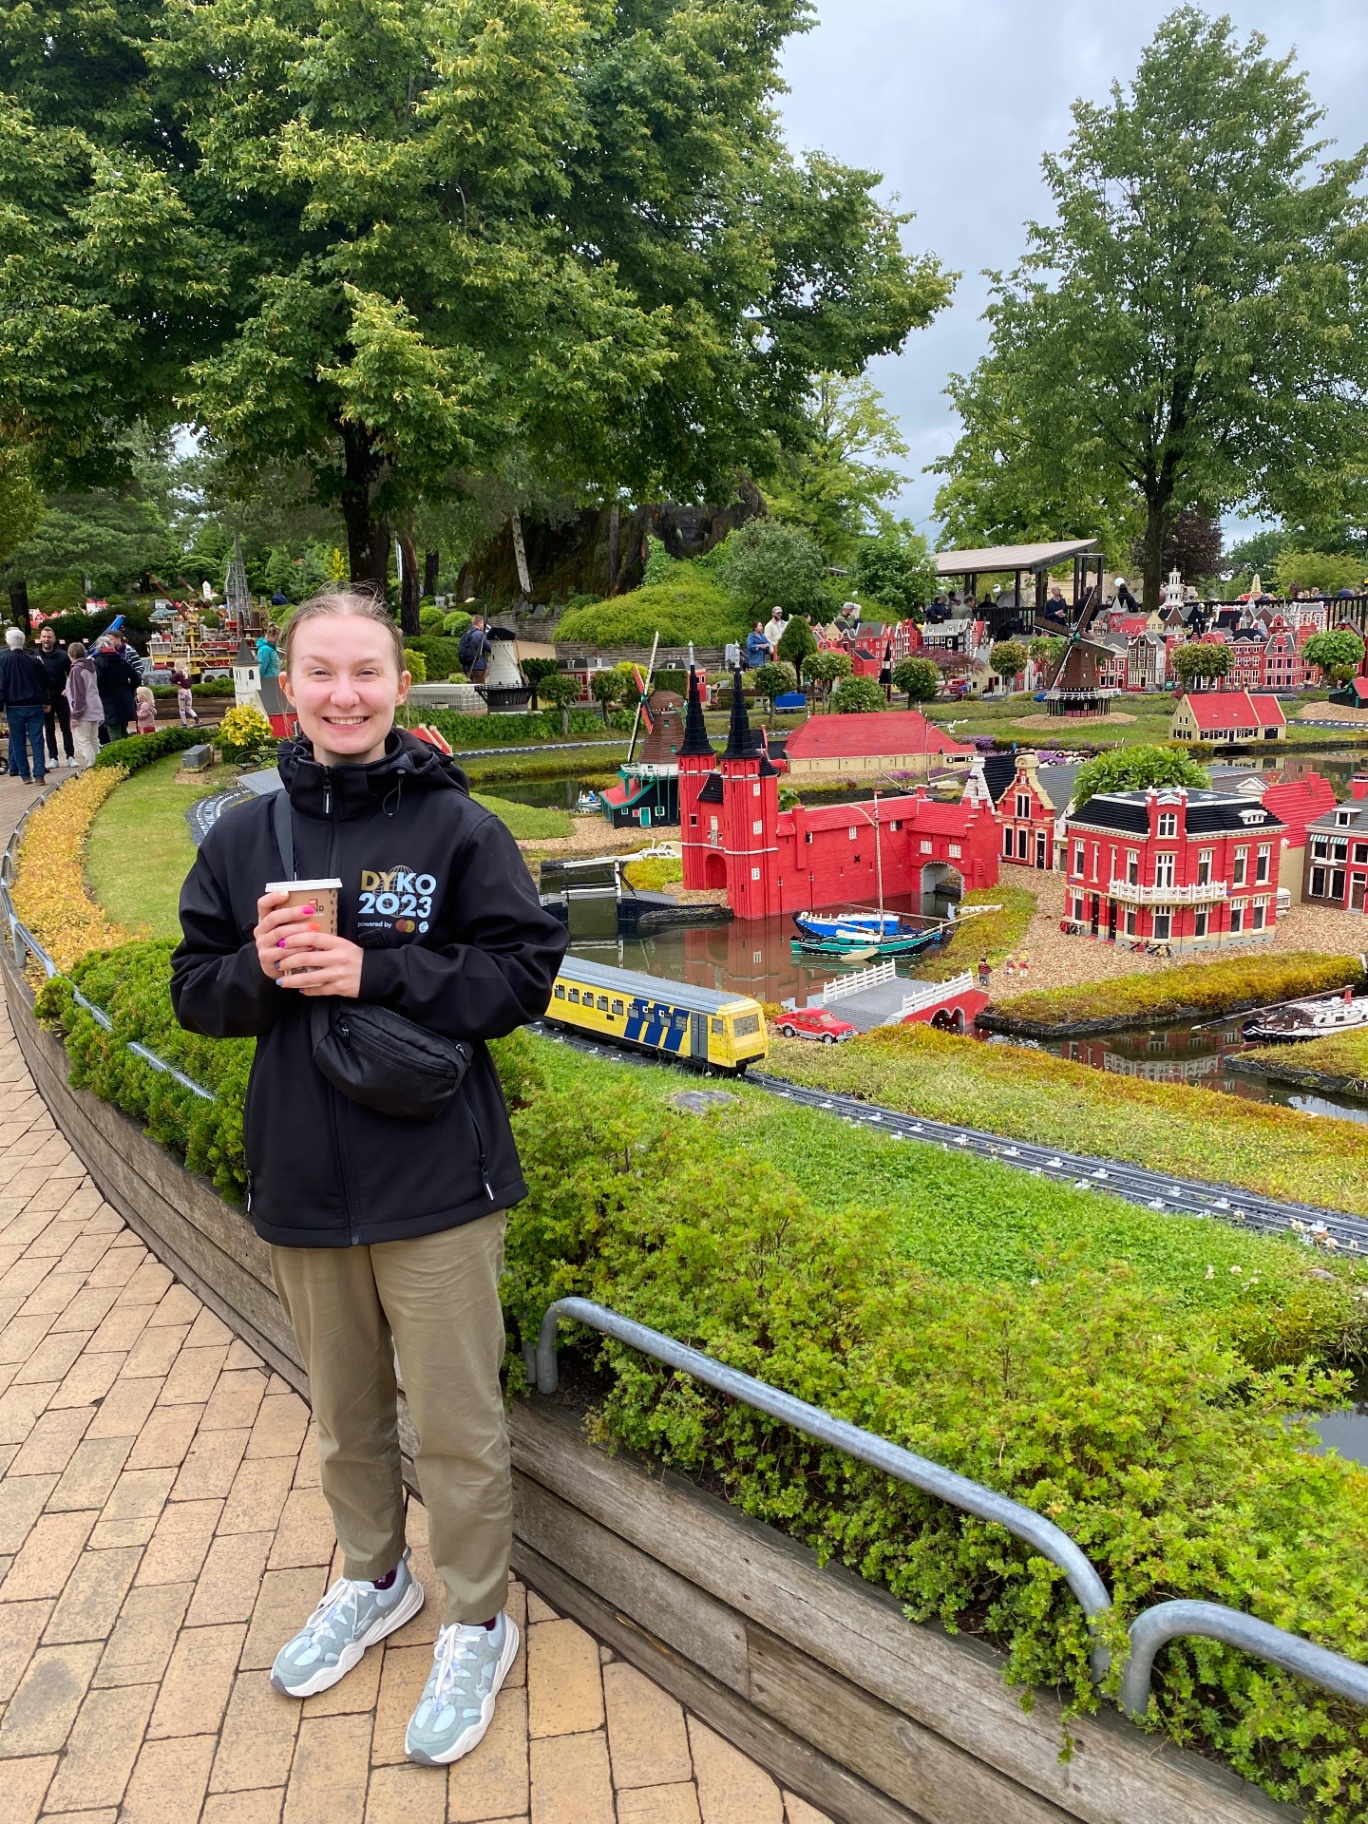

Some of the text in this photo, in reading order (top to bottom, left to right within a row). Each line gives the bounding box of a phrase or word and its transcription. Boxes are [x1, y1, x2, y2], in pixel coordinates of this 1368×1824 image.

[361, 870, 436, 895] DYKO
[358, 892, 432, 918] 2023
[357, 920, 393, 929] powered by
